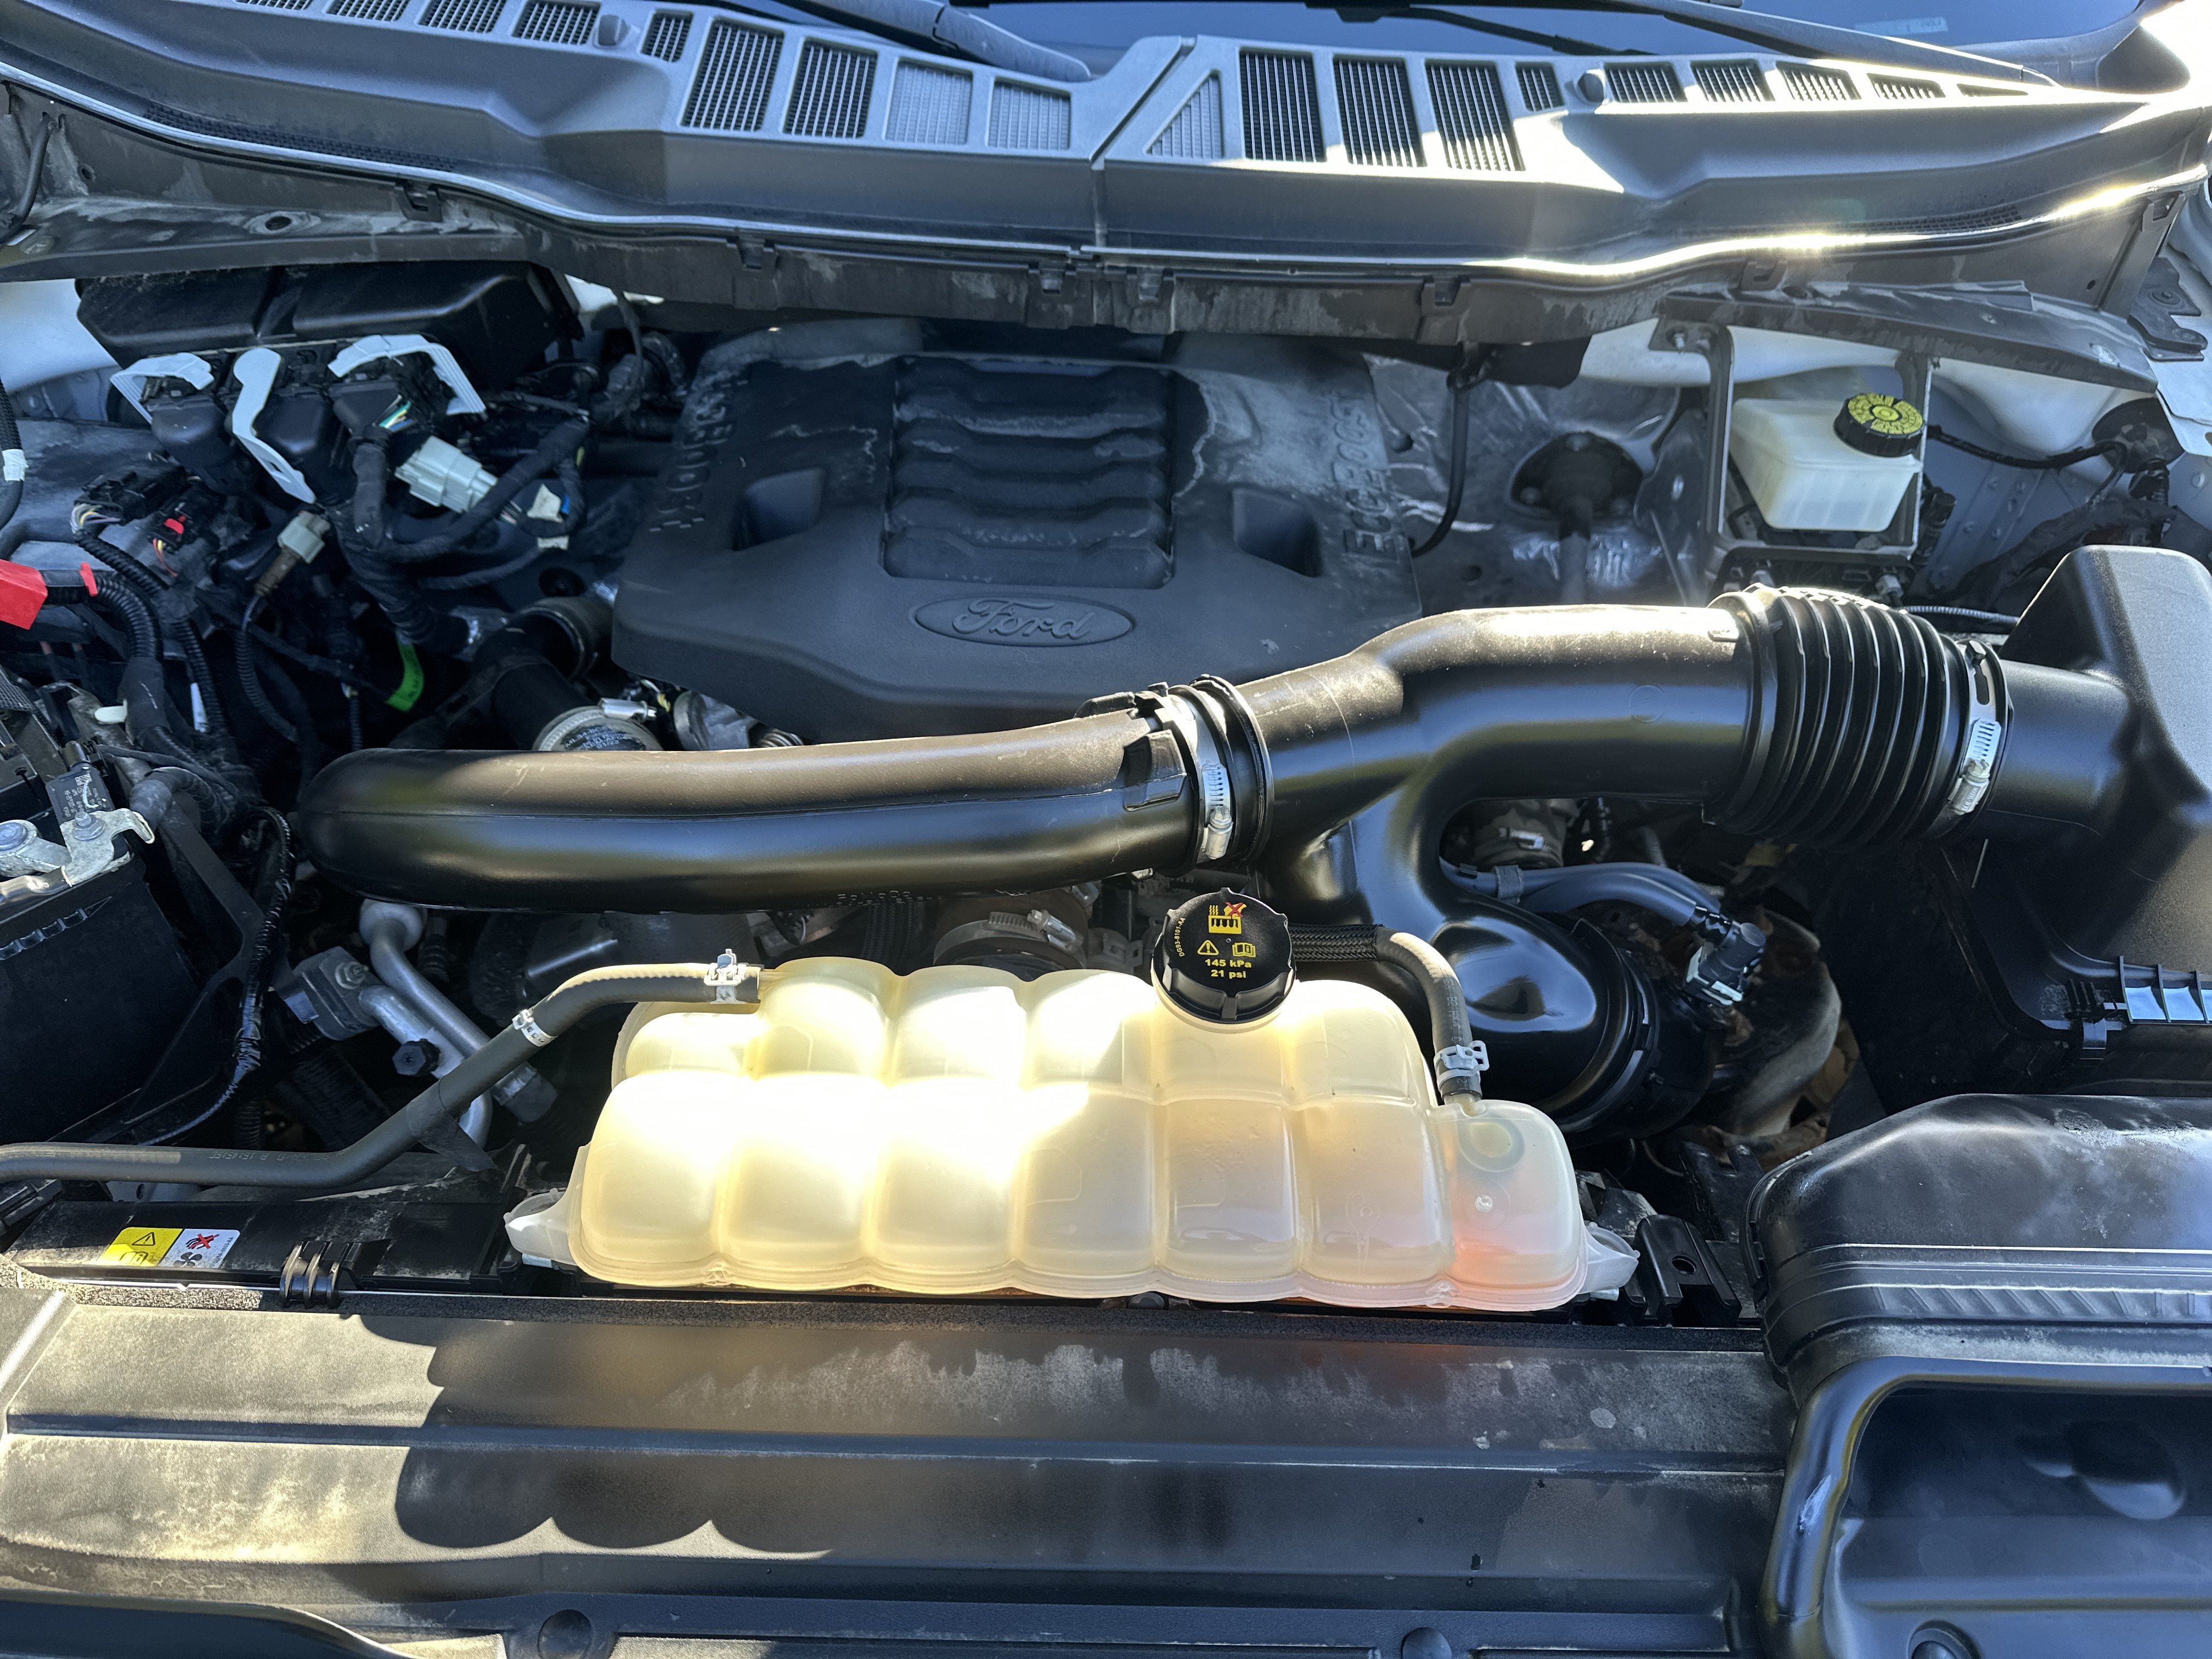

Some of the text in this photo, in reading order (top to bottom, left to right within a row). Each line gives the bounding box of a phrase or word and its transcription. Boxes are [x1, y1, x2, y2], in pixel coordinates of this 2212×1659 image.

[952, 599, 1095, 640] Ford
[1174, 917, 1186, 957] DG93-8101-AA
[1205, 959, 1252, 968] 145 kPa
[1211, 969, 1246, 979] 21 psi
